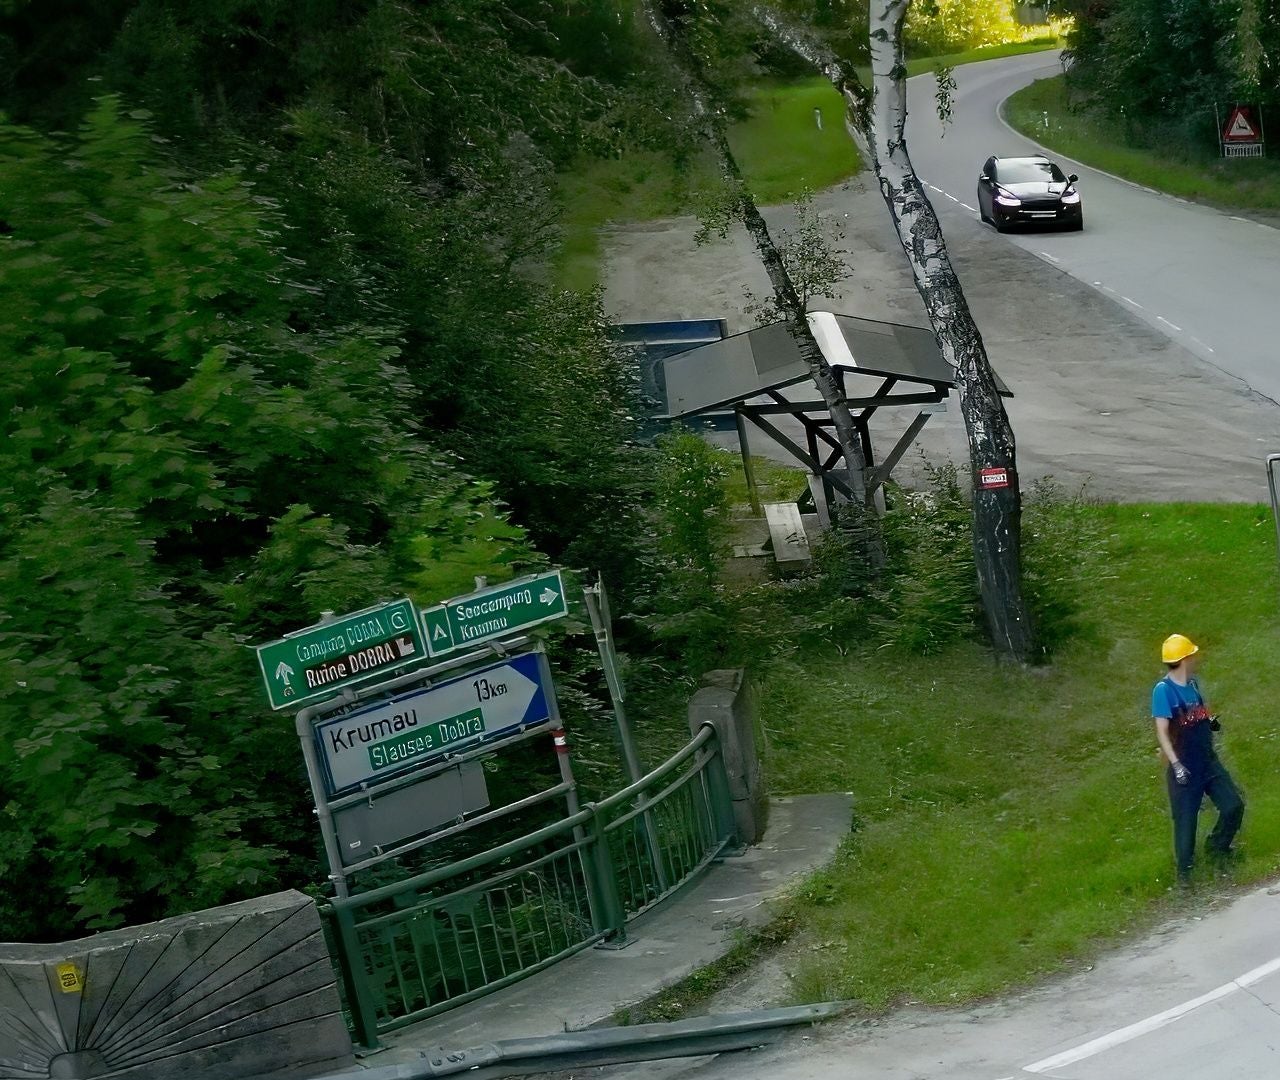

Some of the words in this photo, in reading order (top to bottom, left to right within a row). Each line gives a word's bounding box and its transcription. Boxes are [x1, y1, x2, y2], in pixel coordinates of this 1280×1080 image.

[348, 642, 396, 674] DOBRA
[329, 709, 418, 753] Krumau
[438, 715, 482, 744] Dobra
